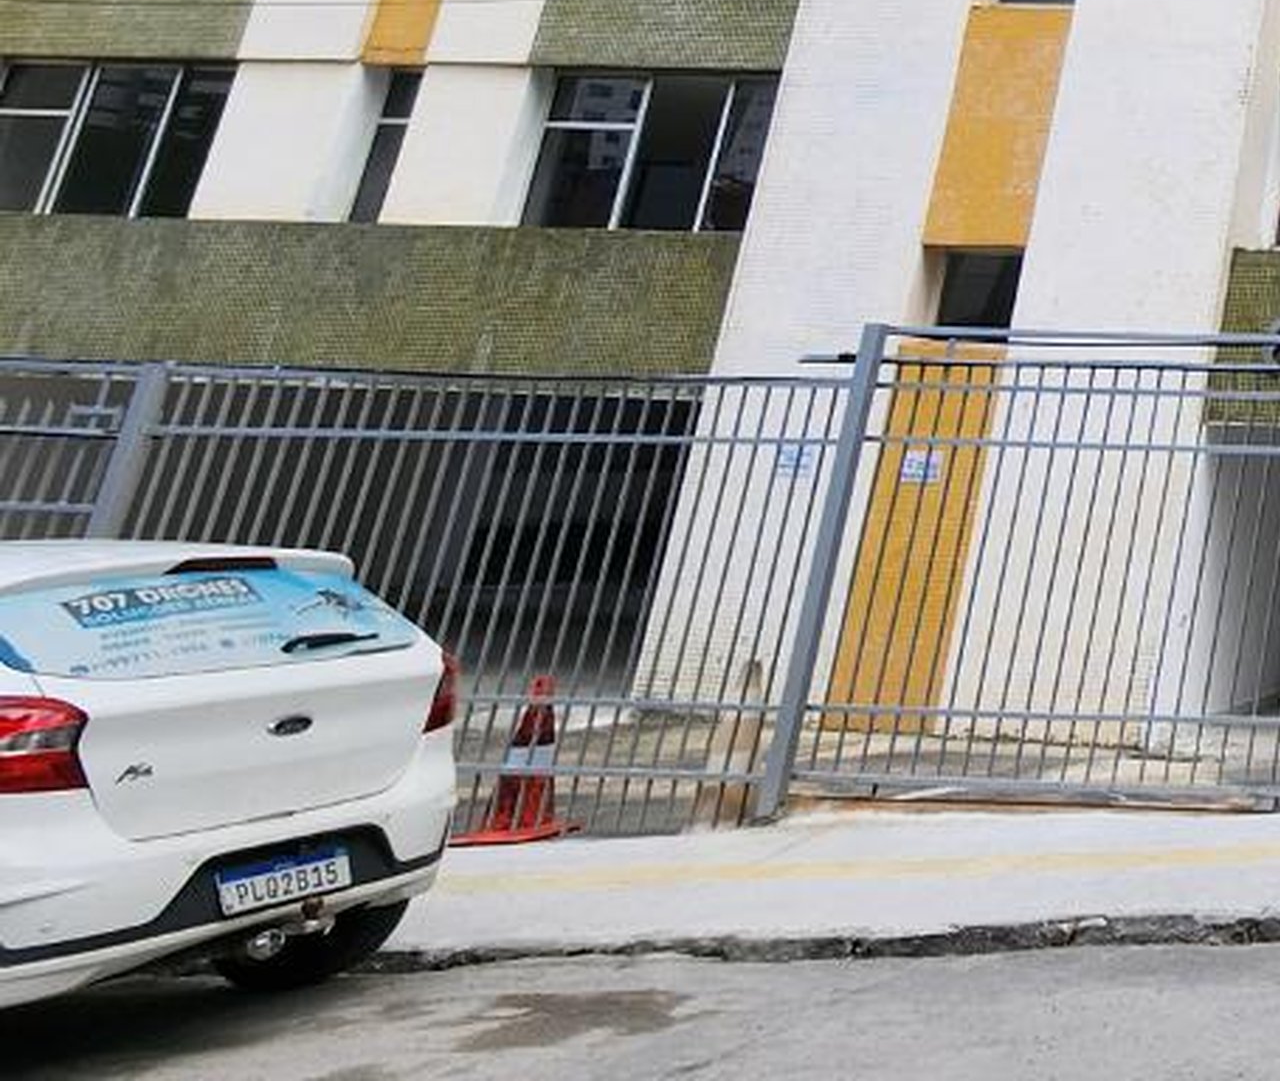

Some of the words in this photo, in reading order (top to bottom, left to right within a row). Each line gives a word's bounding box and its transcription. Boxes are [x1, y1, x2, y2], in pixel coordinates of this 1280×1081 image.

[72, 593, 126, 615] 707
[135, 579, 250, 605] DRONES
[235, 861, 339, 905] PLQ2B15
